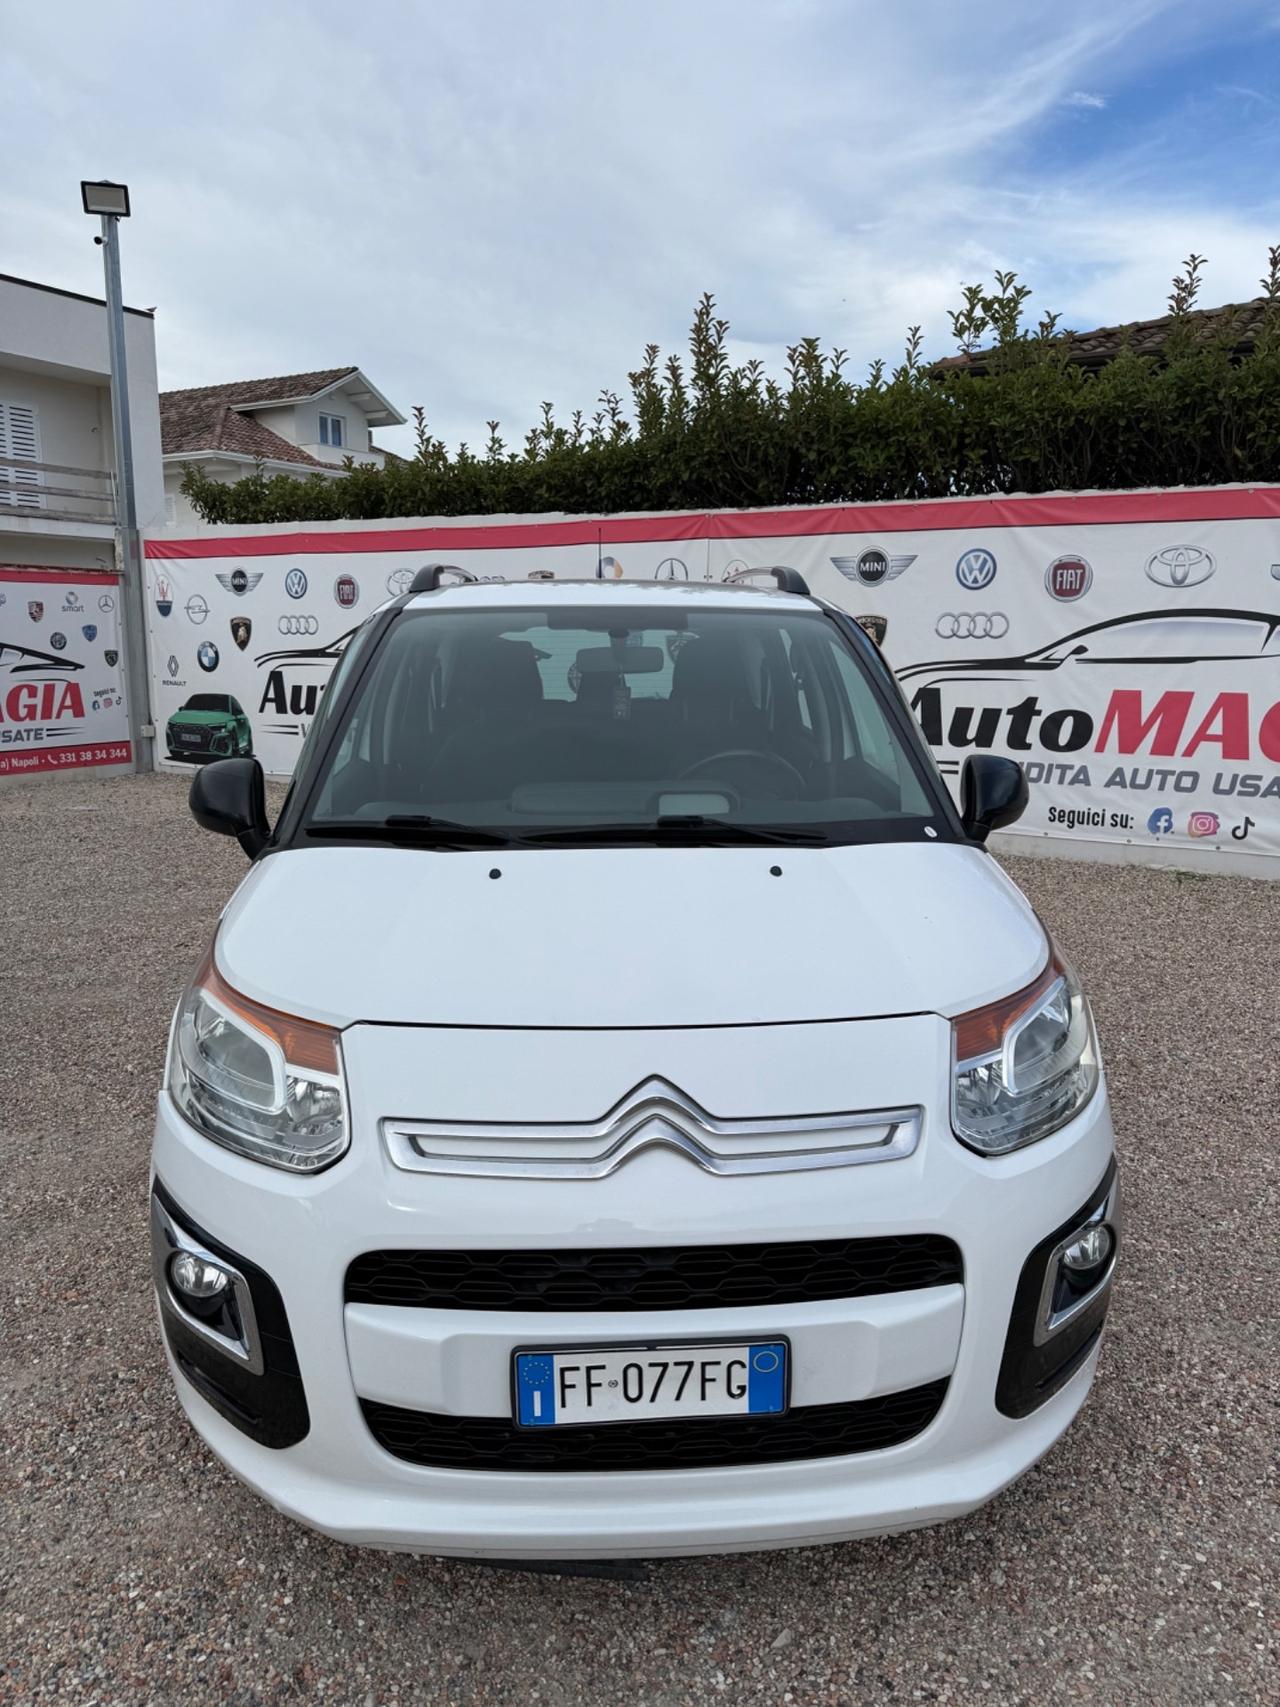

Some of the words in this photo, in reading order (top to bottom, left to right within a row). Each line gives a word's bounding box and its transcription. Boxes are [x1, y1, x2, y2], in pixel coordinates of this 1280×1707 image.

[860, 561, 886, 572] MINI
[1055, 568, 1084, 591] FIAT
[61, 604, 84, 613] smart
[162, 679, 187, 687] RENAULT
[258, 670, 325, 715] Au
[0, 682, 85, 723] GIA
[11, 756, 39, 768] Napoli
[60, 752, 76, 763] 331
[80, 751, 92, 761] 38
[95, 750, 107, 759] 34
[110, 748, 127, 758] 344
[1103, 767, 1200, 793] AUTO
[1048, 806, 1106, 829] Seguici
[1110, 812, 1135, 830] su:
